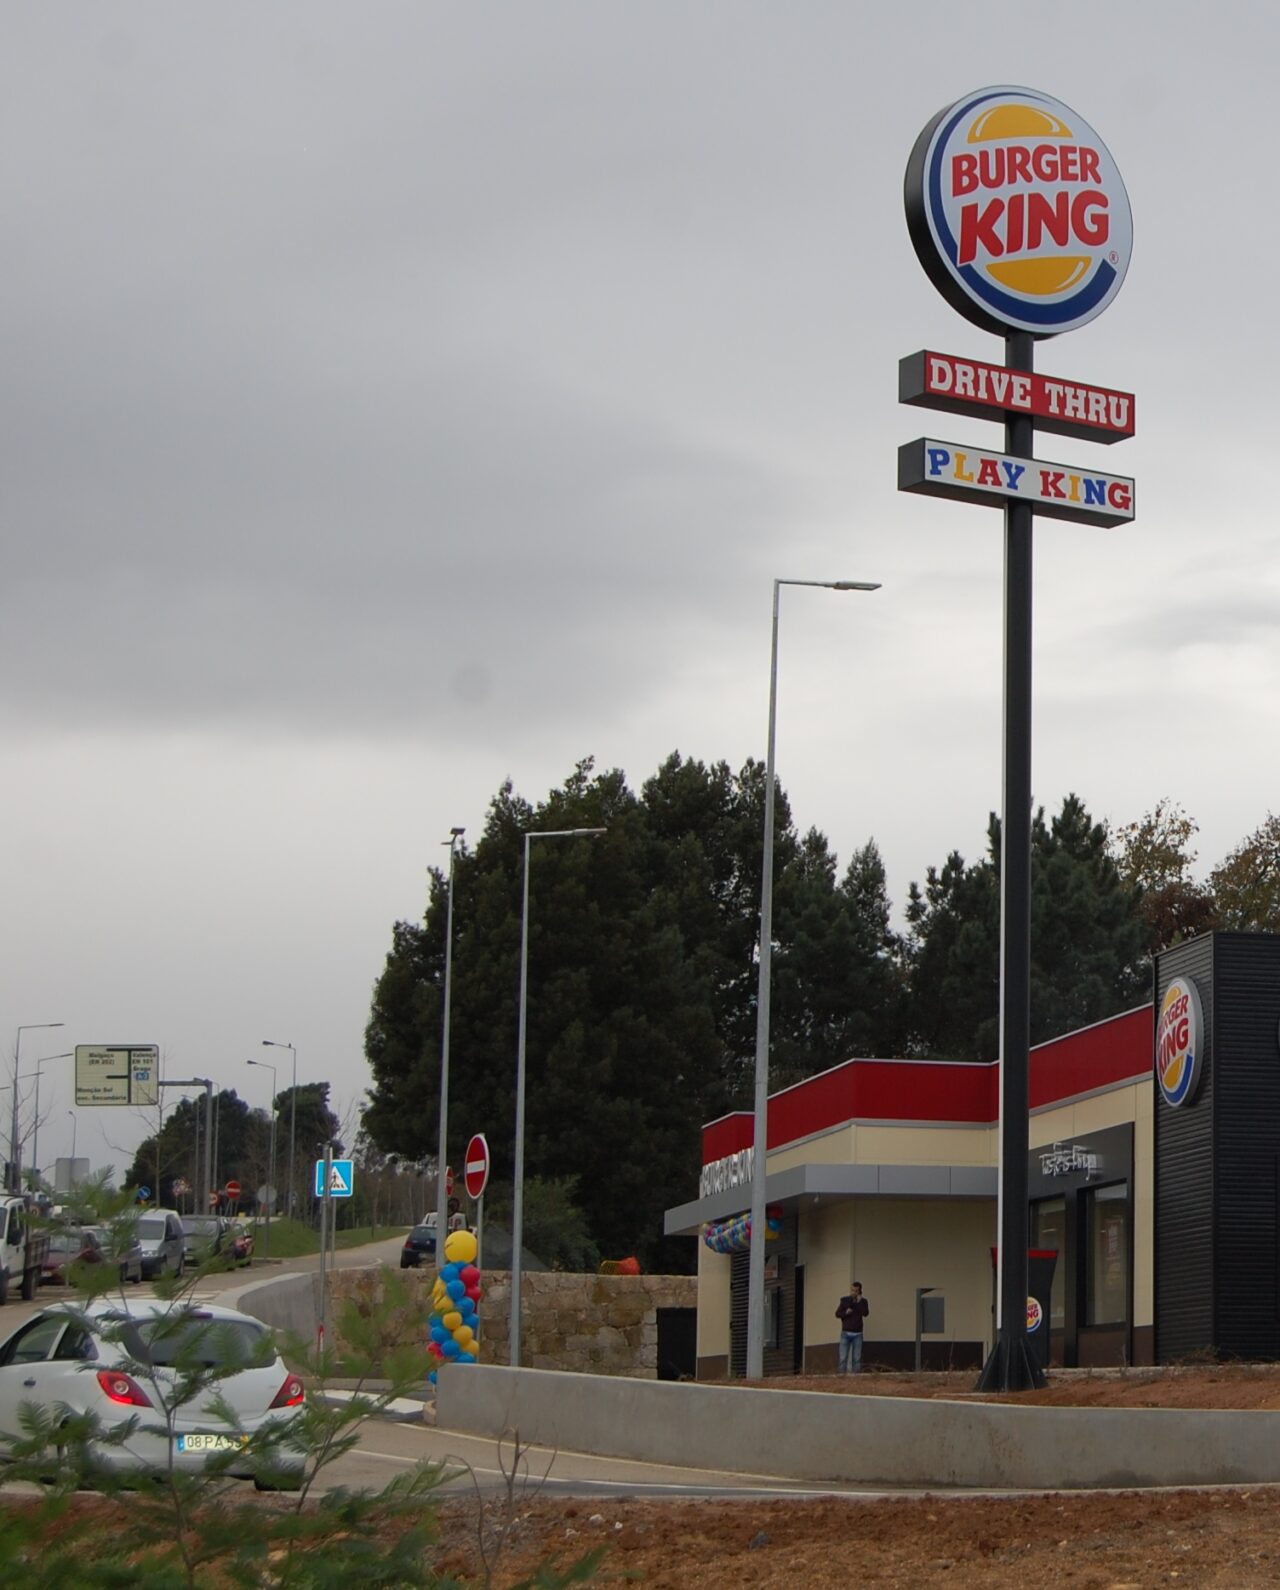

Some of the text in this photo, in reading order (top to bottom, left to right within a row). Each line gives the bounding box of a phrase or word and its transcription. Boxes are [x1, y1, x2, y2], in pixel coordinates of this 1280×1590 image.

[952, 144, 1102, 197] BURGER
[957, 189, 1109, 266] KING
[929, 358, 1129, 428] DRIVE THRU
[927, 448, 1131, 511] PLAY KING
[187, 1436, 202, 1448] 08
[205, 1435, 224, 1448] PA
